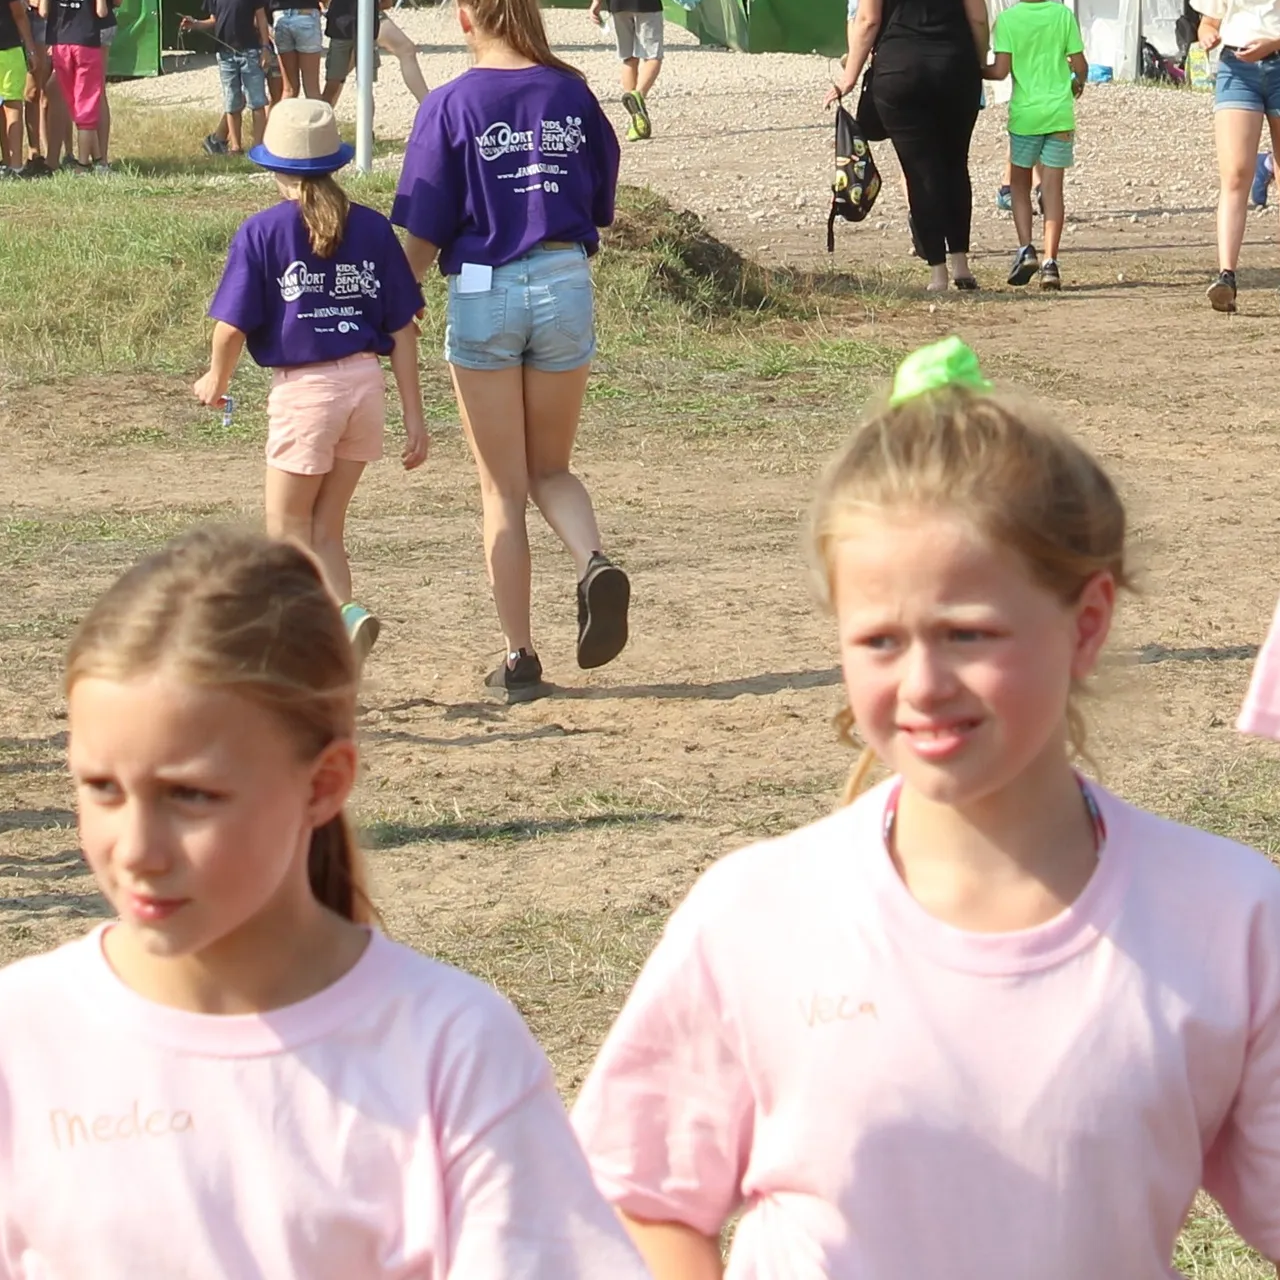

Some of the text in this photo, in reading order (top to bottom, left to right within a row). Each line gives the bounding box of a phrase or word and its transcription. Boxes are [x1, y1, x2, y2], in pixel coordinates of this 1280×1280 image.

[541, 120, 561, 130] KIDS
[476, 128, 534, 148] VAN OORT
[542, 142, 565, 151] CLUB
[336, 264, 357, 272] KIDS
[277, 266, 326, 287] VAN OORT
[335, 284, 359, 294] CLUB
